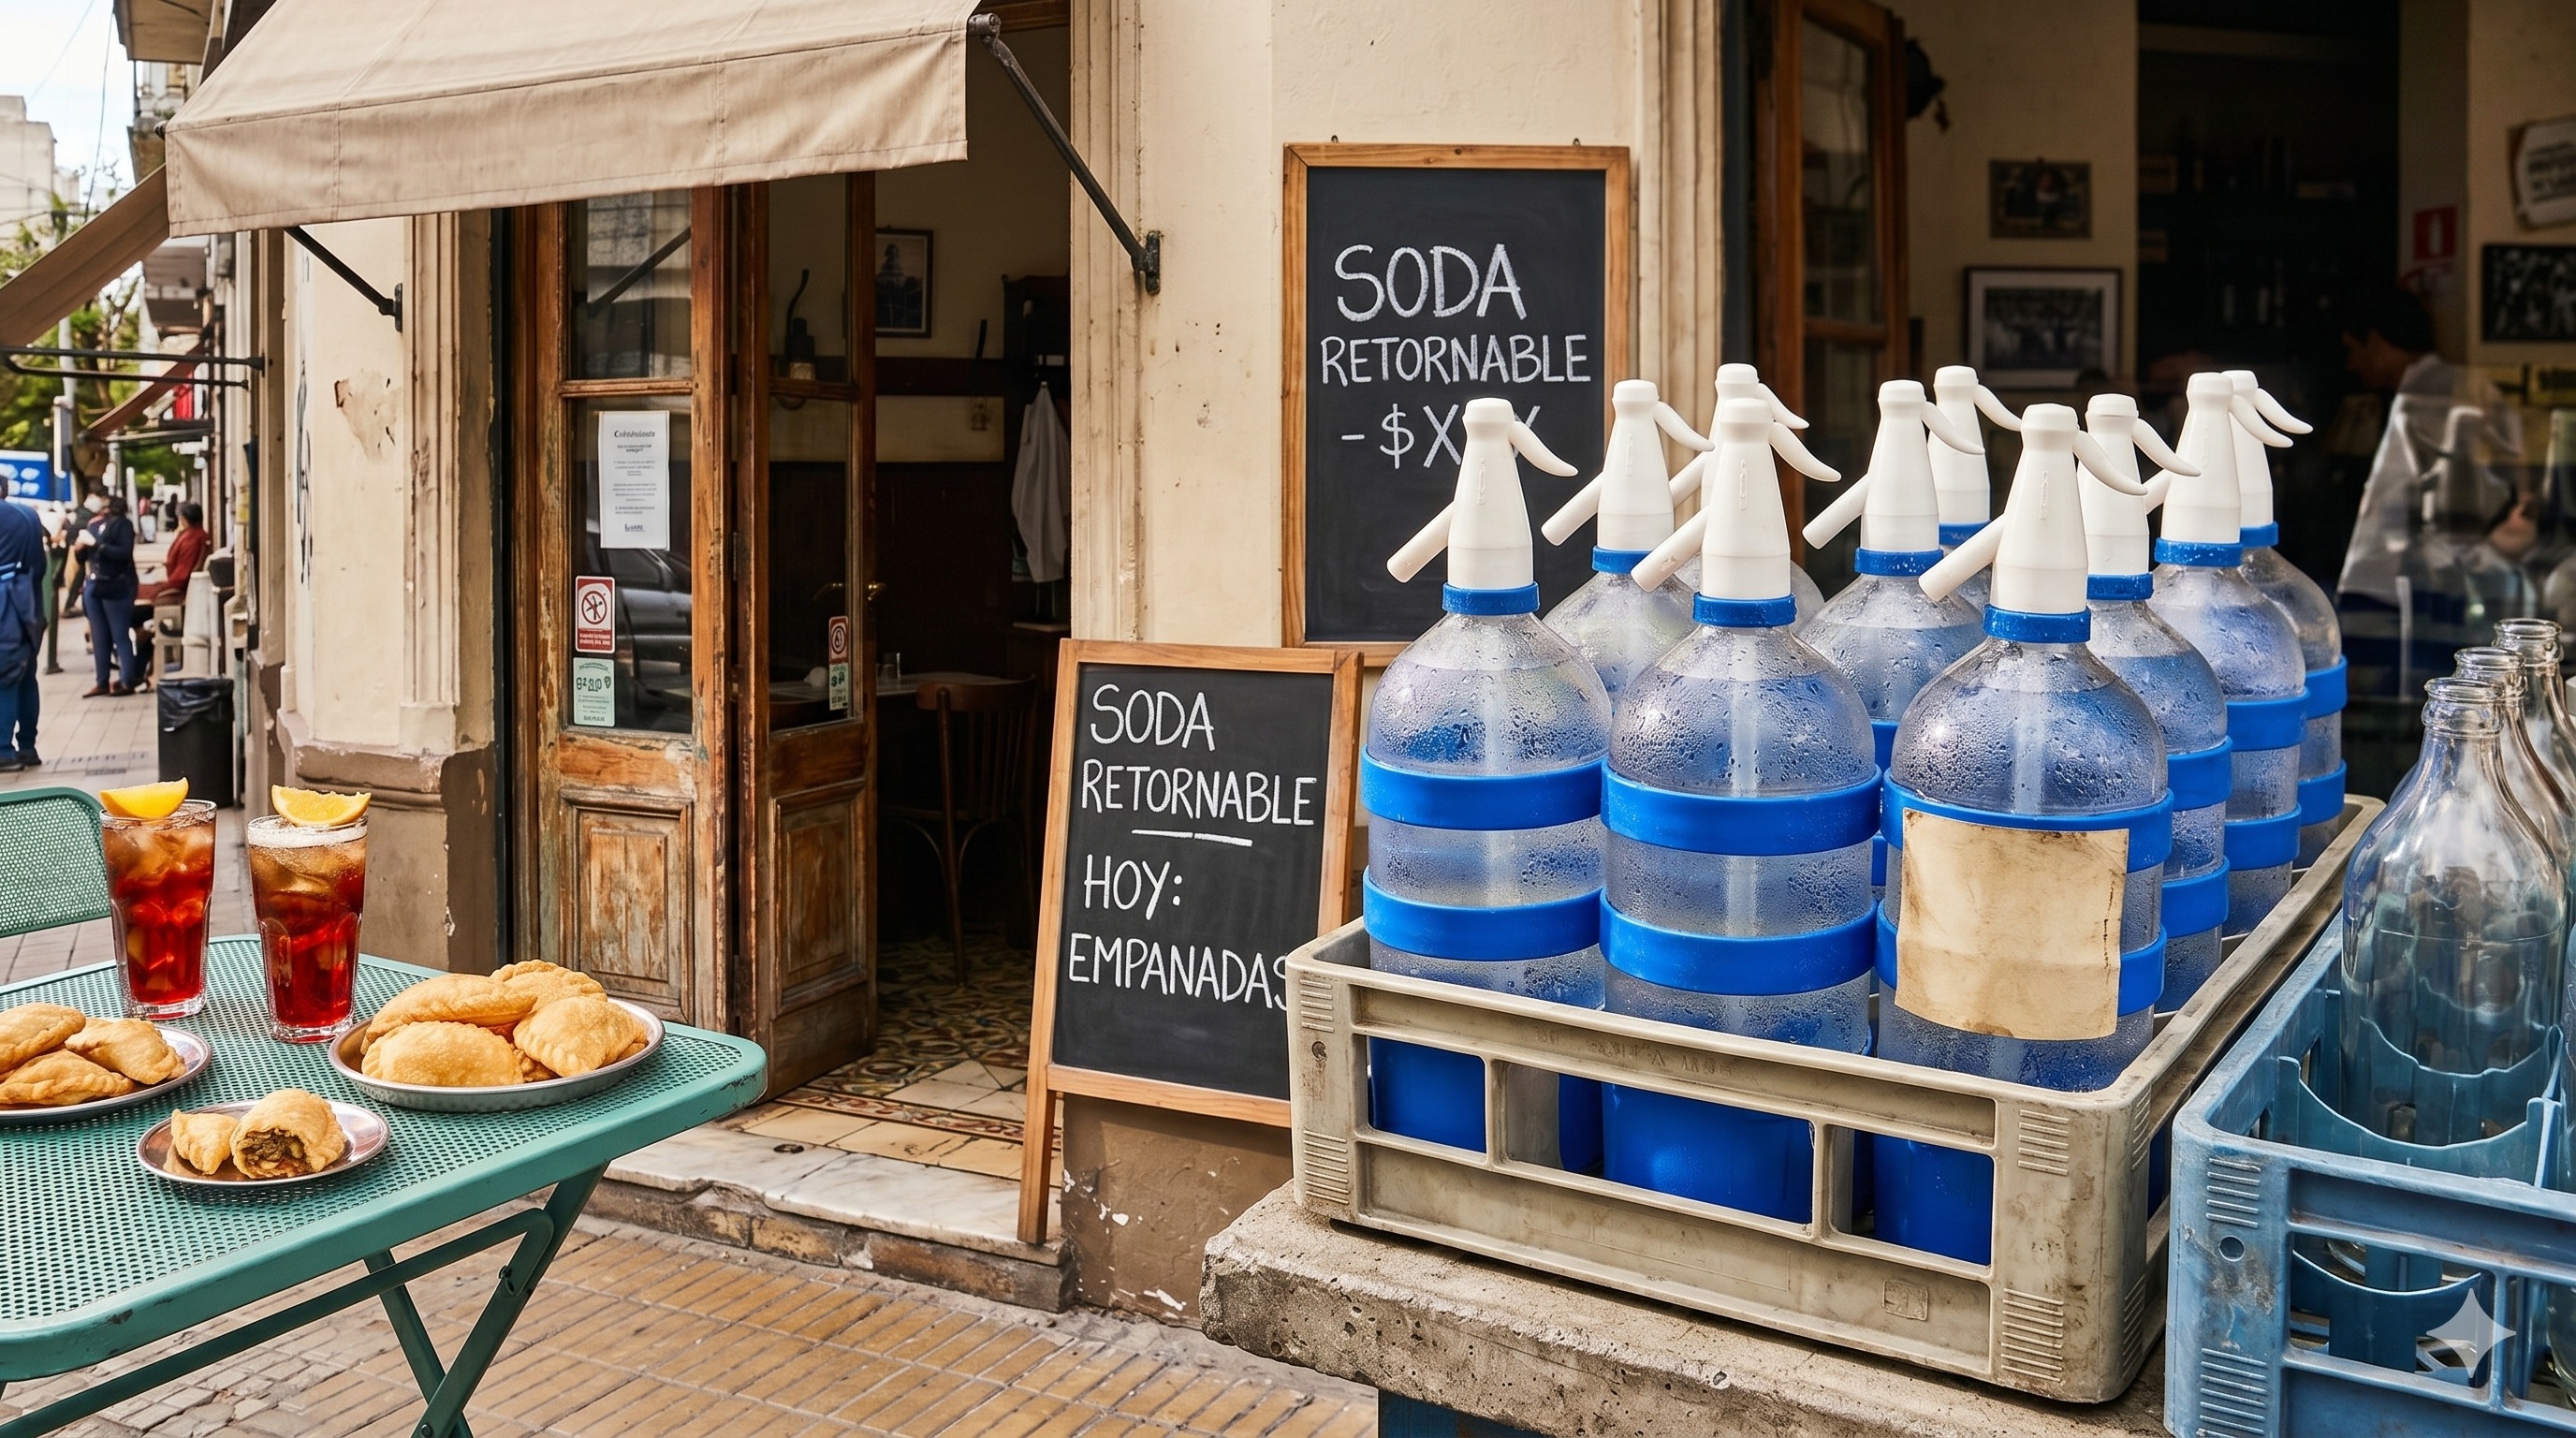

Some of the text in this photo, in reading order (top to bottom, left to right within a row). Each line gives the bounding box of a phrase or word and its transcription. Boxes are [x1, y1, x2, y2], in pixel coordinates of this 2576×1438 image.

[1335, 243, 1527, 321] SODA
[1321, 334, 1590, 386] RETORNABLE
[1380, 404, 1541, 469] $X
[1090, 683, 1216, 751] SODA
[1082, 758, 1317, 825] RETORNABLE
[1084, 854, 1182, 920] HOY:
